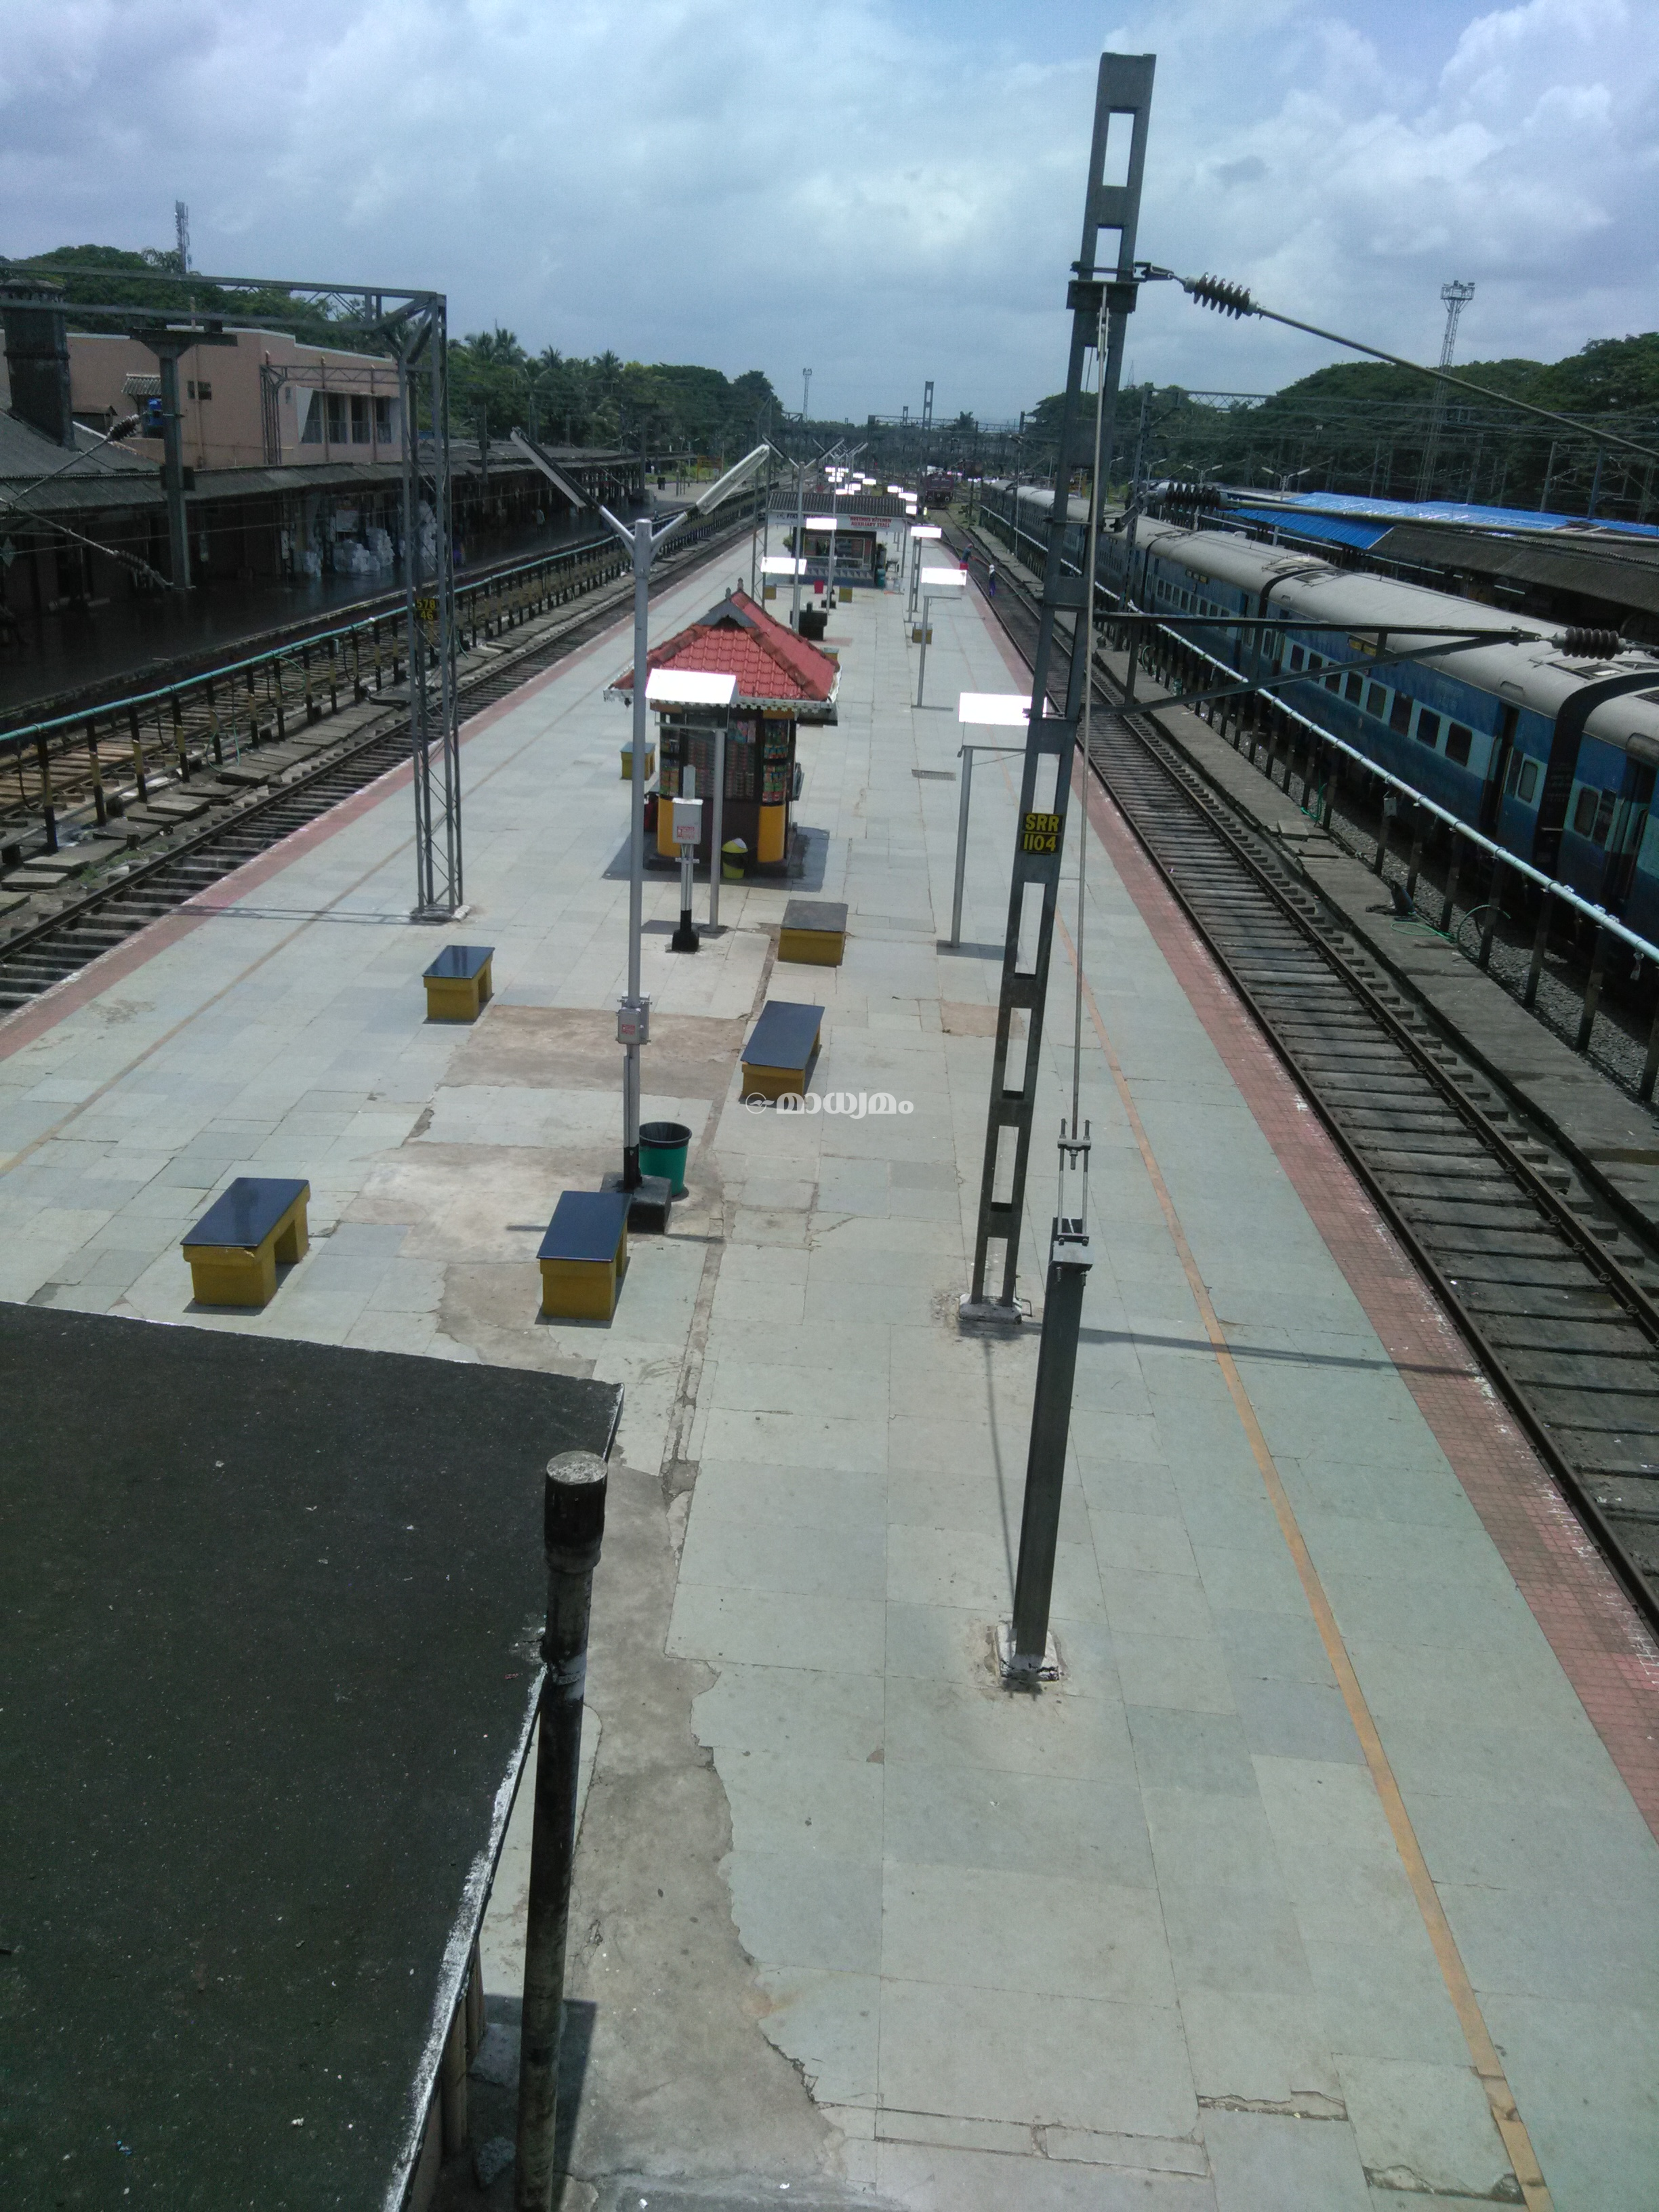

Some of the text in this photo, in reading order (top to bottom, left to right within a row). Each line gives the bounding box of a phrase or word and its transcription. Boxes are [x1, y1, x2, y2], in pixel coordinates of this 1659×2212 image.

[416, 599, 436, 609] 578
[420, 610, 434, 620] 46
[1025, 814, 1060, 832] SRR
[1023, 834, 1057, 852] 1104
